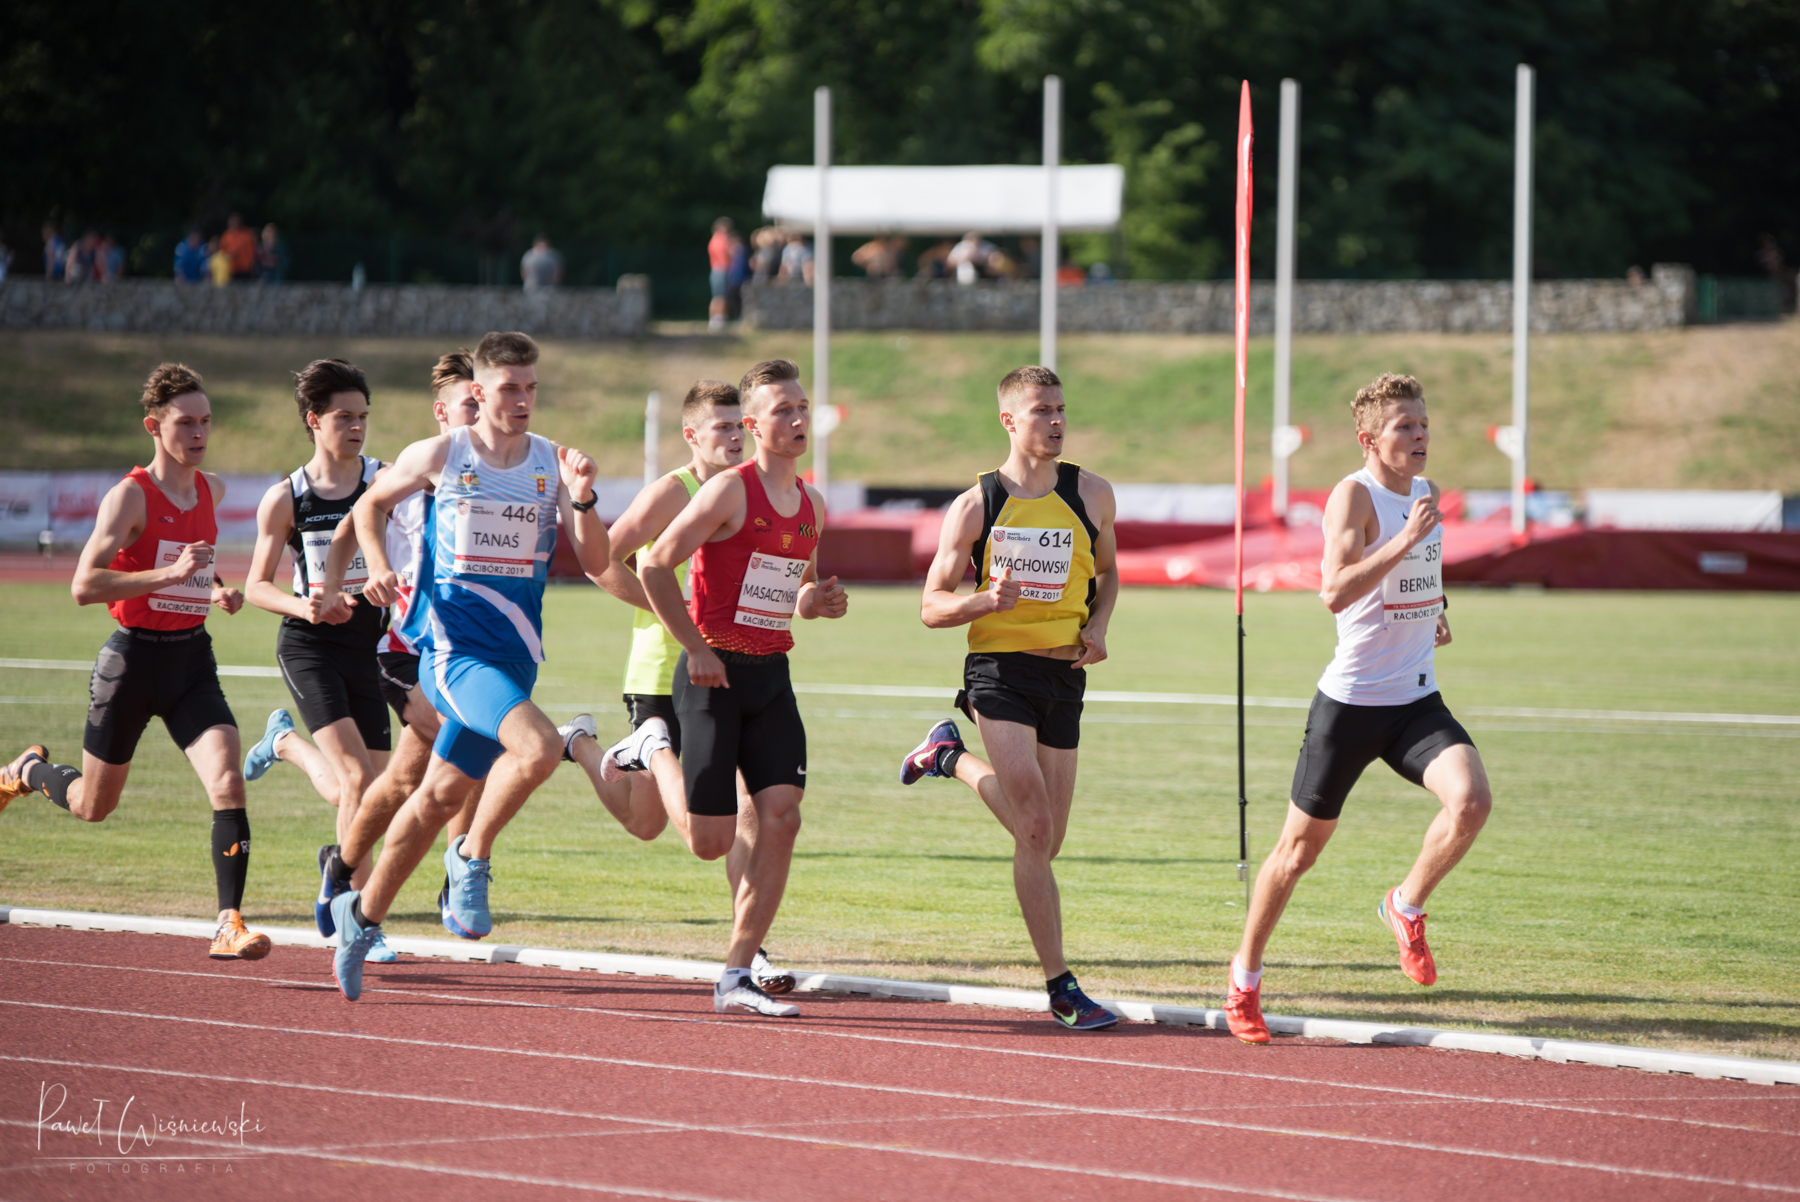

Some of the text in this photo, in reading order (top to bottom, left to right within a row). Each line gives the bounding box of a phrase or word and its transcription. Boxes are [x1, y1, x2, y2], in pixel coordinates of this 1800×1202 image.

[305, 513, 347, 523] KONDY
[501, 505, 536, 523] 446
[473, 532, 520, 549] TANAŚ
[1038, 530, 1072, 548] 614
[1425, 542, 1442, 562] 357
[506, 566, 525, 575] 2019
[785, 562, 805, 578] 548
[994, 555, 1069, 574] WACHOWSKI
[1041, 592, 1059, 600] 2019
[157, 601, 209, 614] RACIBÓRZ 2019
[1394, 609, 1430, 620] RACIBÓRZ
[742, 615, 786, 629] RACIBÓRZ 2019
